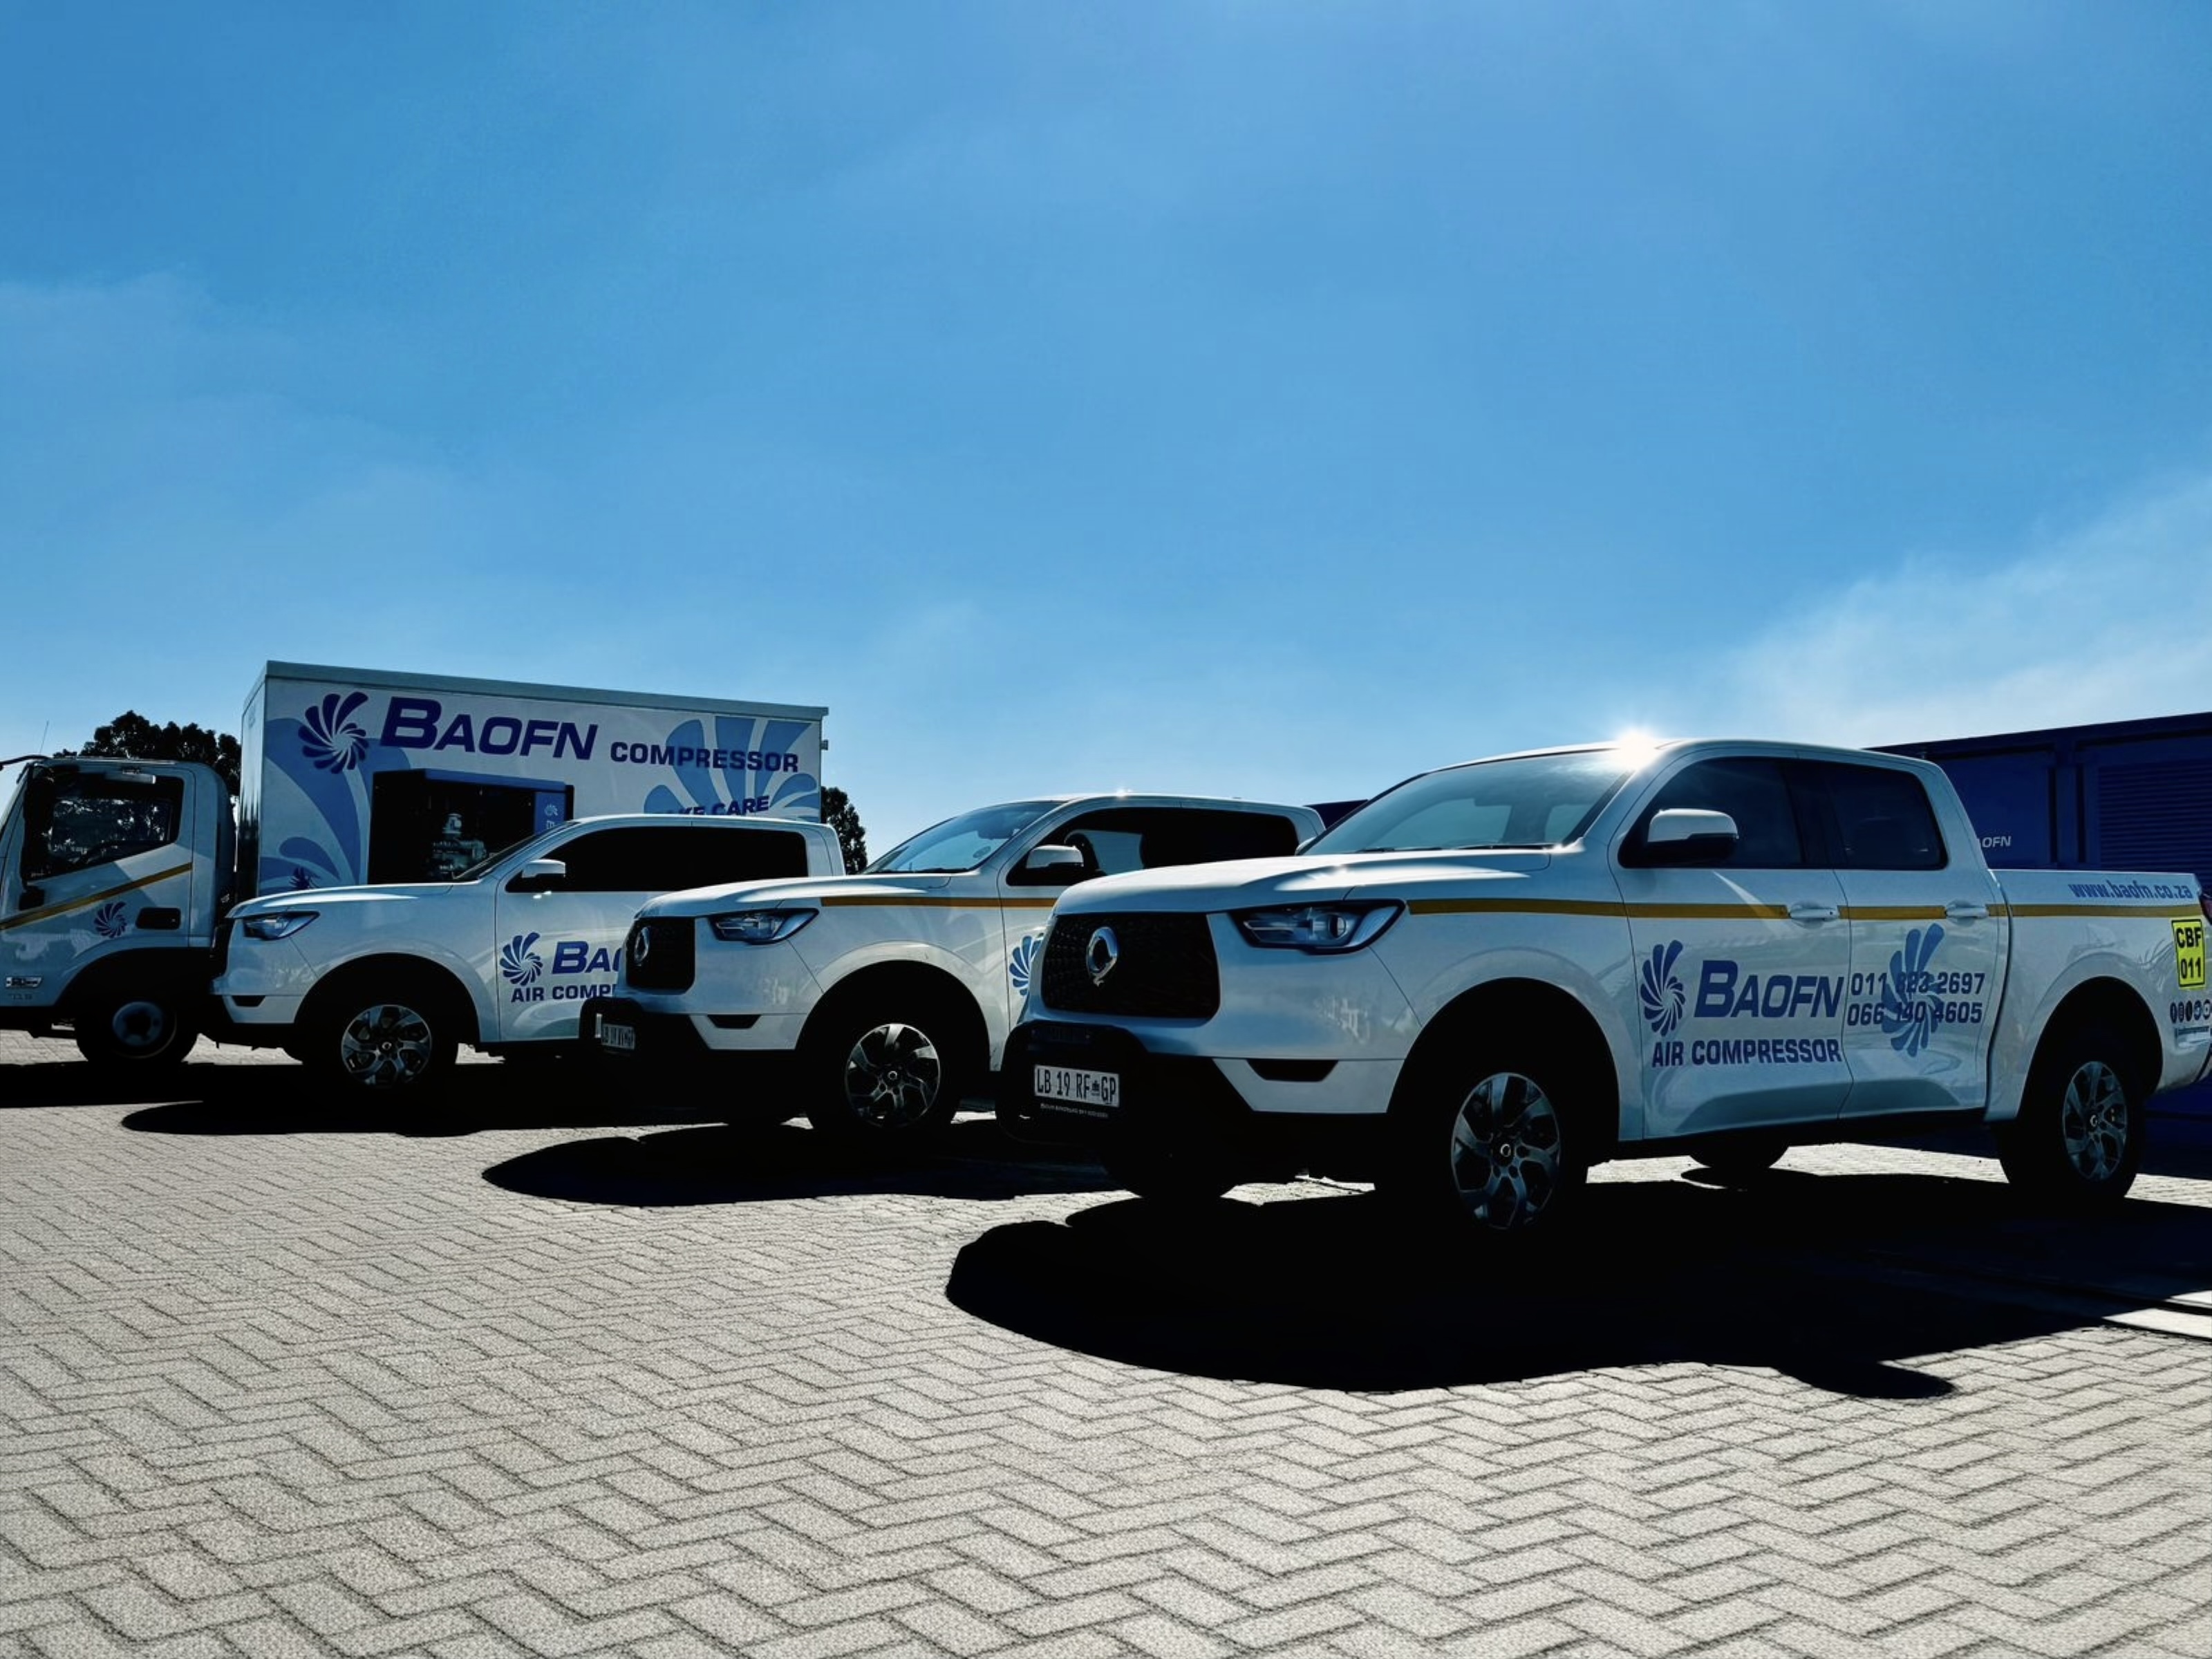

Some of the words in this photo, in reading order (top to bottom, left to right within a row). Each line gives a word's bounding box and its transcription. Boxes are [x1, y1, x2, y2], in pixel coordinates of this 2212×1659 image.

[379, 696, 599, 760] BAOFN
[610, 742, 798, 772] COMPRESSOR
[711, 796, 769, 816] CARE
[1978, 836, 2012, 847] OFN
[2068, 880, 2193, 899] www.baofn.co.za
[2176, 927, 2202, 948] CBF
[2181, 957, 2201, 979] 011
[511, 986, 545, 1003] AIR
[552, 984, 616, 1000] COMP
[1694, 960, 1844, 1018] BAOFN
[1851, 973, 1887, 995] 011
[1938, 972, 1985, 994] 2697
[1848, 1003, 1884, 1026] 066
[1934, 1001, 1983, 1023] 4605
[1651, 1041, 1684, 1067] AIR
[1691, 1039, 1842, 1065] COMPRESSOR
[1038, 1068, 1051, 1094] LB
[1057, 1071, 1070, 1096] 19
[1076, 1073, 1090, 1099] RF
[1101, 1076, 1116, 1103] GP
